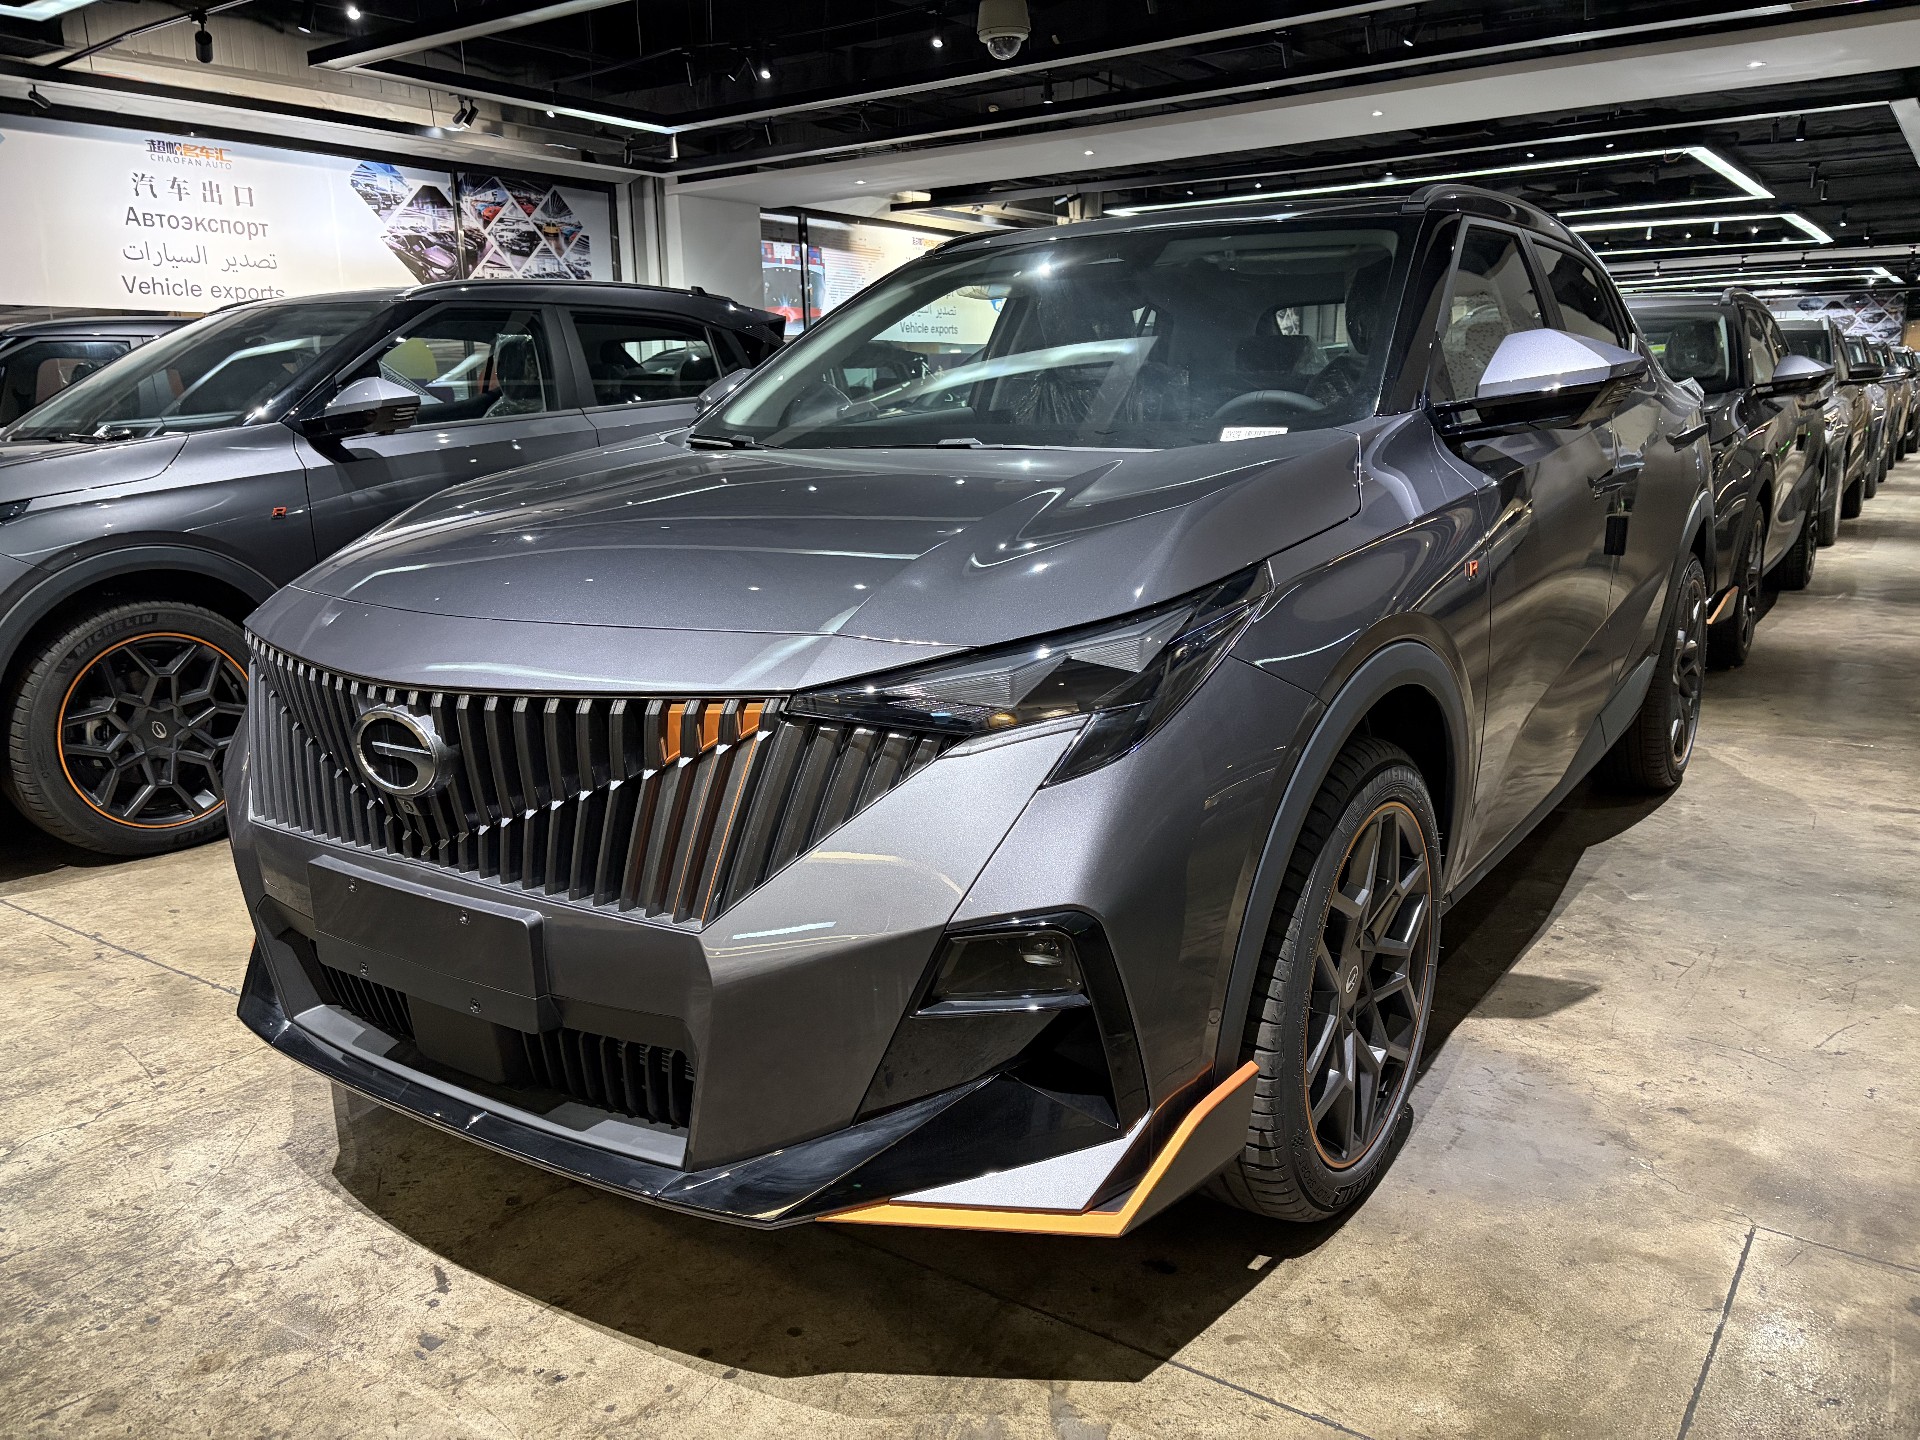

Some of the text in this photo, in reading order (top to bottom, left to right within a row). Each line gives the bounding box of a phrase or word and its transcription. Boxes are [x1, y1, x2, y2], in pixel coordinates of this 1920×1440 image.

[150, 153, 232, 170] CHAOFAN AUTO
[131, 171, 254, 207] 汽车出口
[125, 206, 269, 240] Автоэкспорт
[122, 241, 278, 273] تصدير السيارات
[121, 274, 286, 302] Vehicle exports
[900, 321, 958, 336] Vehicle exports
[74, 613, 153, 657] MICHELIN
